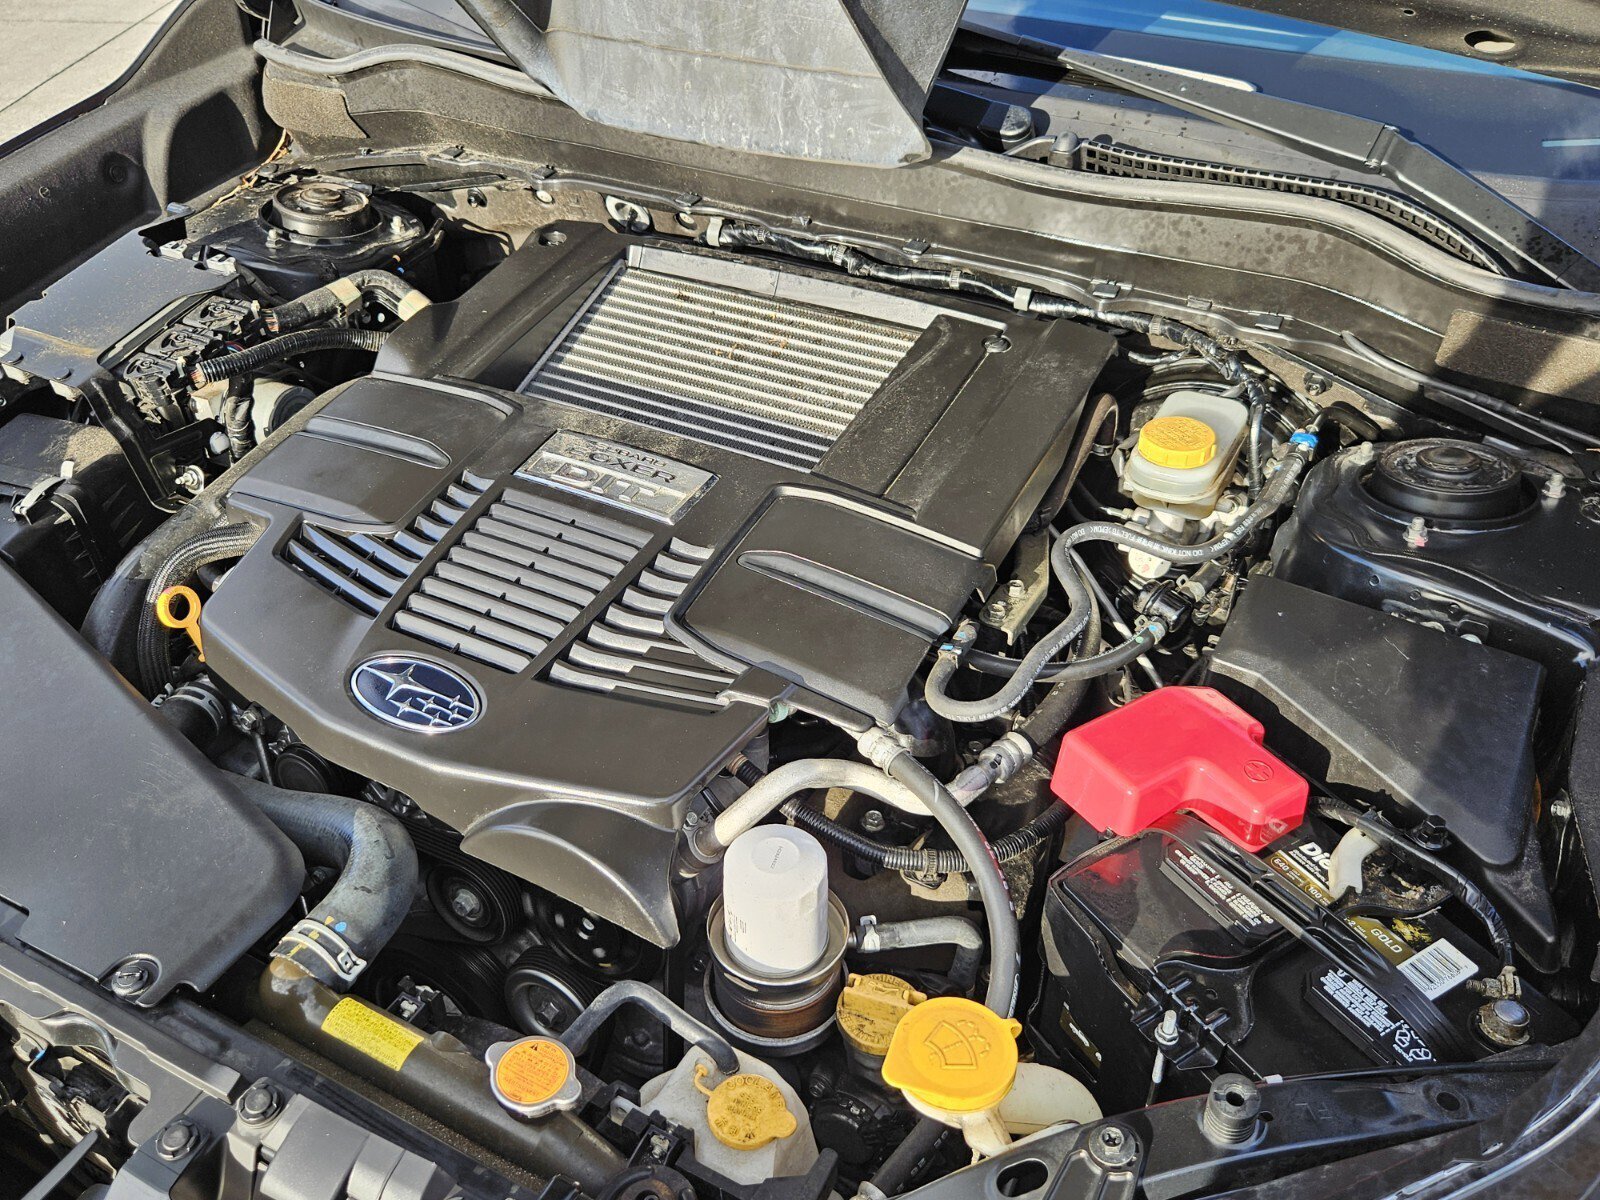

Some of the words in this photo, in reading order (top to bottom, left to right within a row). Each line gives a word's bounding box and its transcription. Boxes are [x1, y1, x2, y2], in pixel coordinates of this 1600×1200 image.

[551, 463, 657, 502] DIT
[1273, 857, 1289, 871] 640
[1308, 886, 1322, 898] 100
[1369, 927, 1403, 953] GOLD
